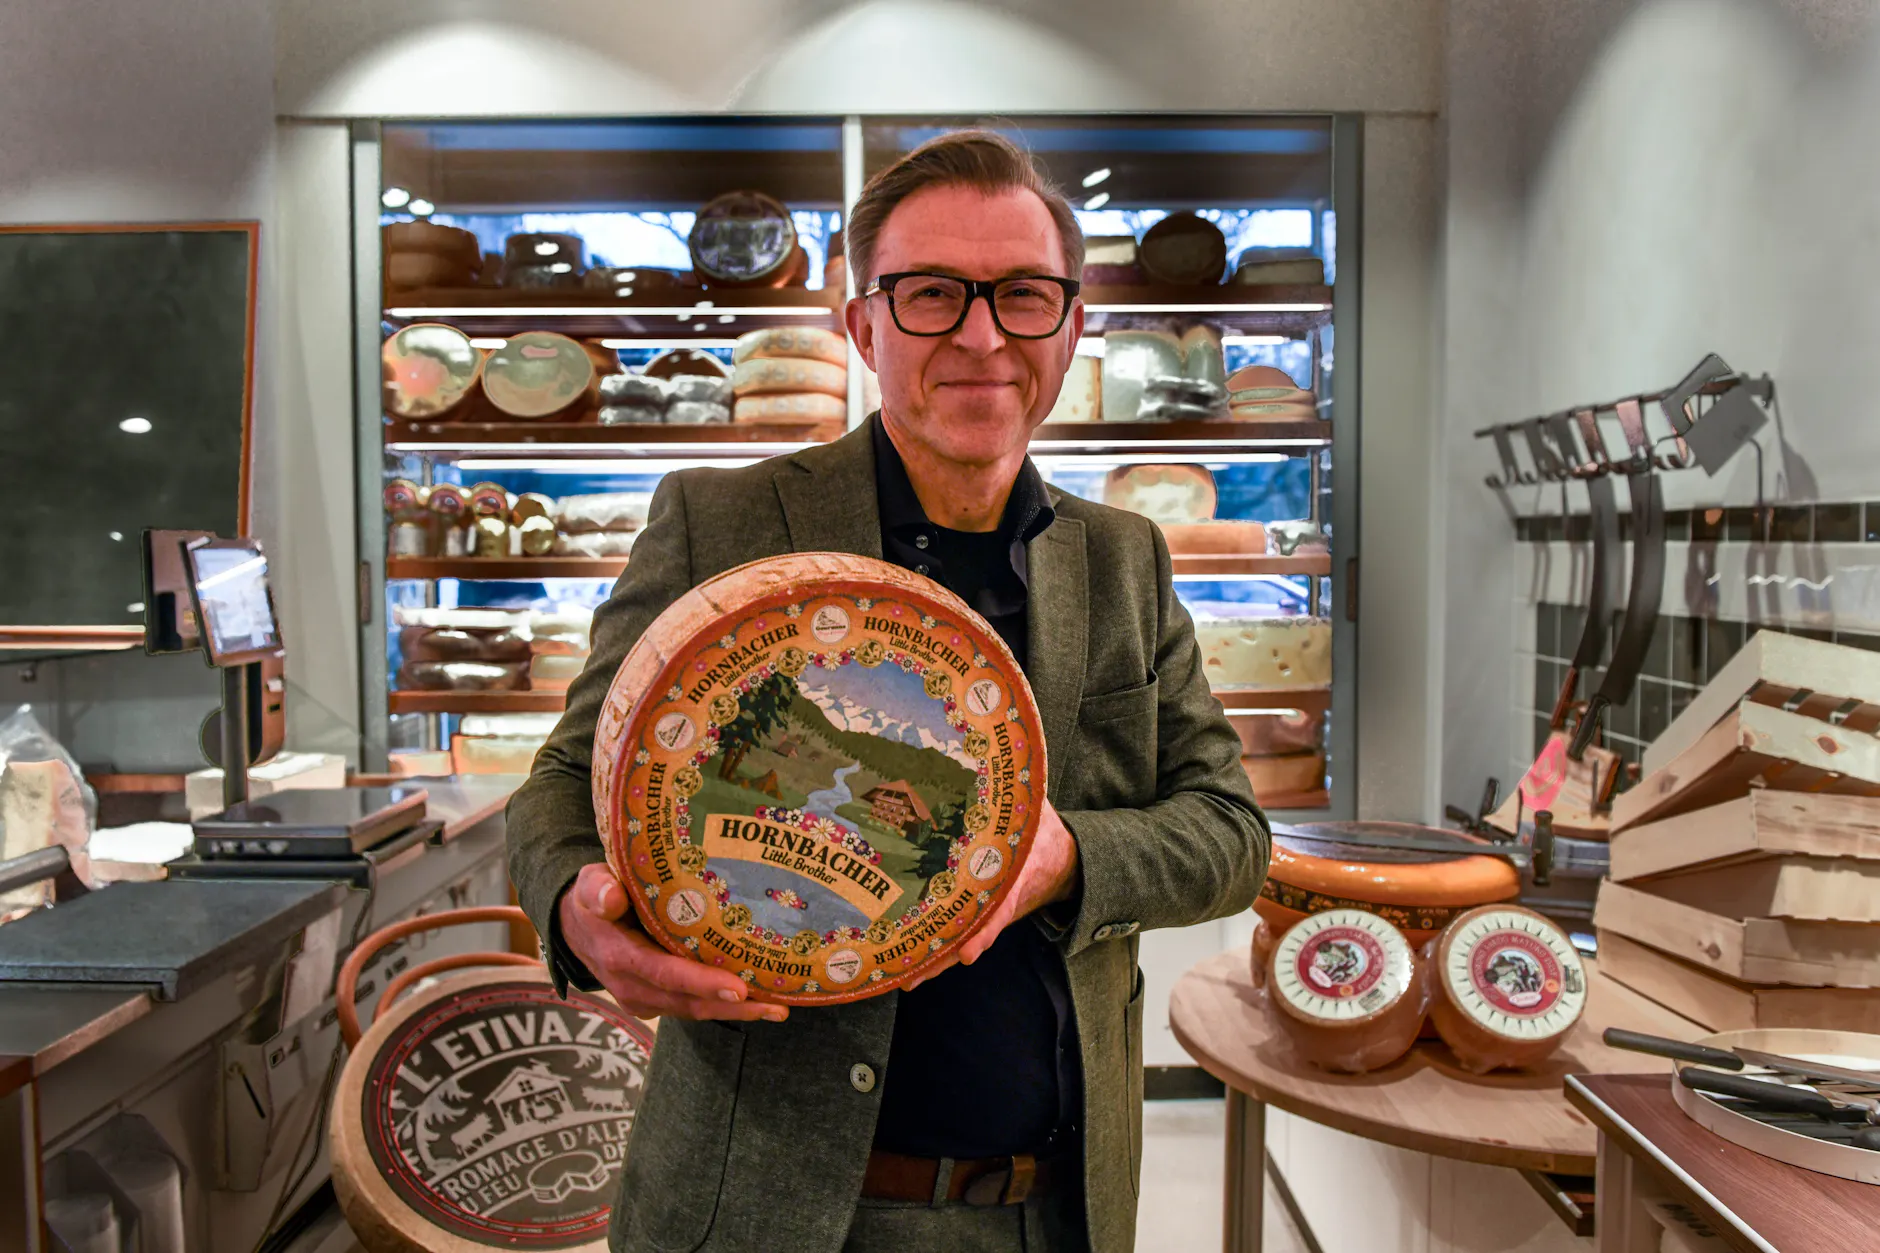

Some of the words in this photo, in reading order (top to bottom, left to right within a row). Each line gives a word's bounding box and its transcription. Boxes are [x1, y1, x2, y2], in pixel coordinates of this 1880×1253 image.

[688, 623, 800, 705] HORNBACHER
[864, 616, 970, 677] HORNBACHER
[889, 637, 909, 650] Little
[910, 644, 938, 665] Brother
[720, 669, 742, 688] Little
[740, 651, 771, 675] Brother
[991, 756, 1001, 776] Little
[993, 722, 1015, 836] HORNBACHER
[992, 777, 1002, 807] Brother
[646, 762, 674, 884] HORNBACHER
[661, 796, 672, 828] Brother
[663, 827, 675, 851] Little
[719, 818, 891, 901] HORNBACHER
[761, 847, 792, 866] Little
[793, 859, 837, 886] Brother
[873, 889, 974, 965] HORNBACHER
[900, 919, 927, 939] Brother
[926, 904, 945, 921] Little
[703, 927, 812, 977] HORNBACHER
[737, 936, 766, 954] Brother
[769, 947, 787, 960] Little
[435, 1136, 553, 1201] ROMAGE
[558, 1119, 633, 1150] D'ALP
[477, 1171, 521, 1205] FEU
